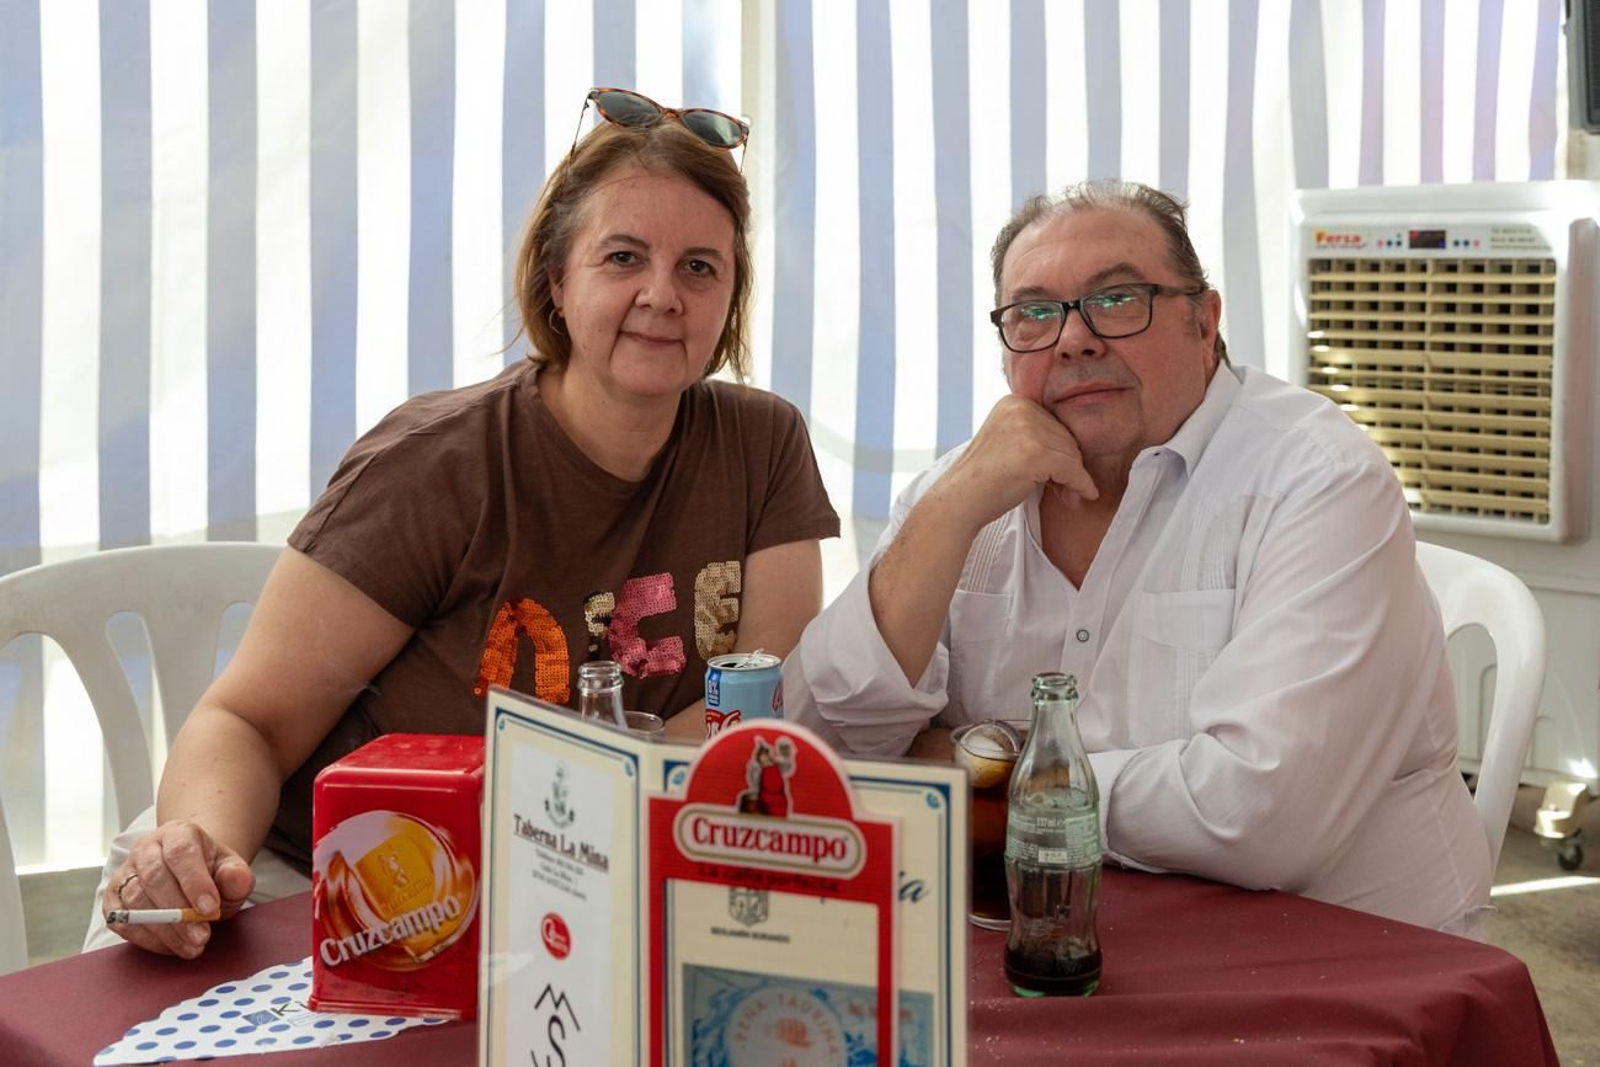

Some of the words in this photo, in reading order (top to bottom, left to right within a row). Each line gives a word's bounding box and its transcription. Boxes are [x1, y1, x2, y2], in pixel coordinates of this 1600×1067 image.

[513, 812, 557, 850] Taberna
[560, 833, 576, 859] La
[691, 816, 847, 864] Cruzcampo
[319, 894, 462, 967] Cruzcampo
